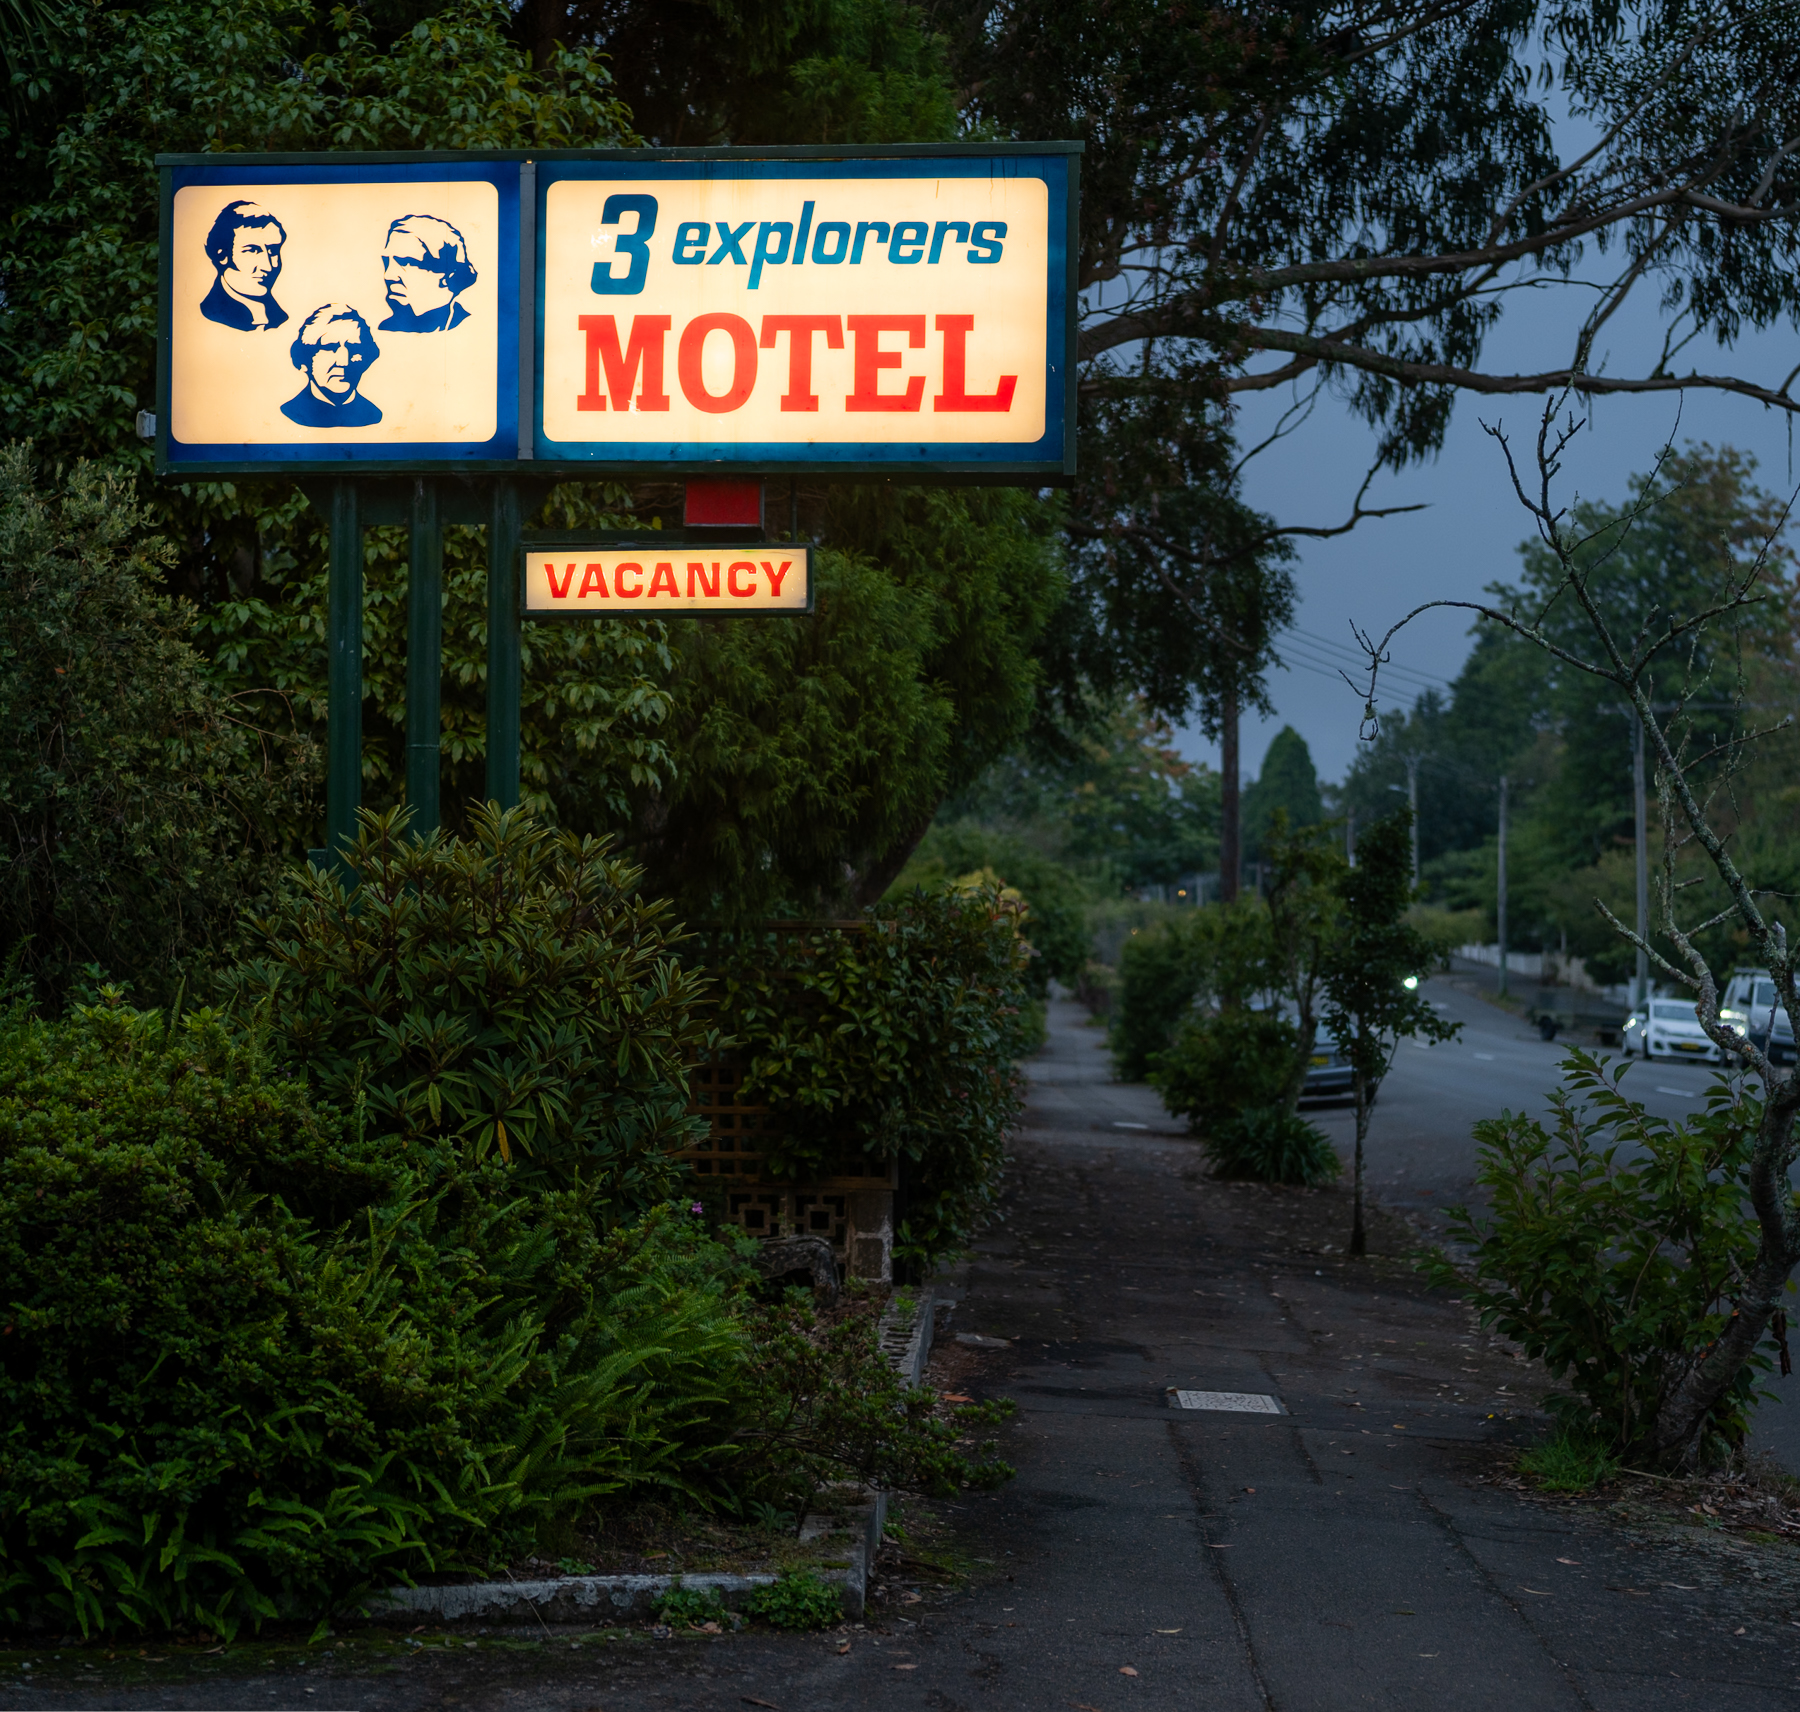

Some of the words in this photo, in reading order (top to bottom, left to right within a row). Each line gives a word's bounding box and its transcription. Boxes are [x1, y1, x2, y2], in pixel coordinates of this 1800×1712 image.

[591, 194, 658, 295] 3
[672, 201, 1008, 290] explorers
[577, 312, 1018, 413] MOTEL
[544, 562, 792, 599] VACANCY
